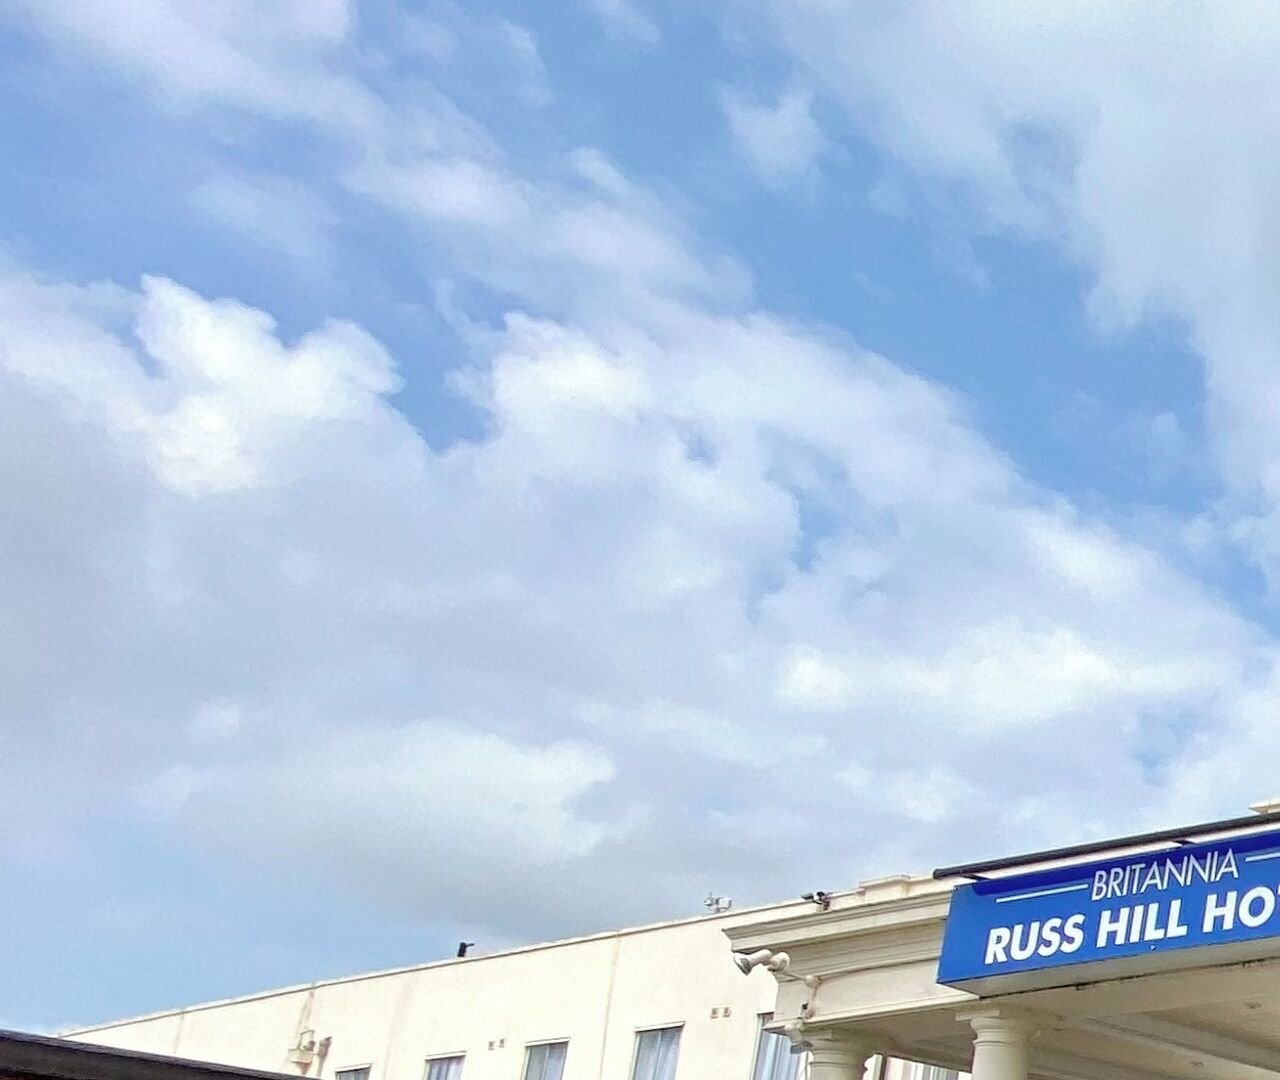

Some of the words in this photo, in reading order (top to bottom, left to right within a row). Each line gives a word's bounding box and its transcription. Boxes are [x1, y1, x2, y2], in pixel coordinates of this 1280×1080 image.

[1091, 849, 1239, 901] BRITANNIA
[984, 914, 1086, 965] RUSS
[1096, 899, 1188, 948] HILL
